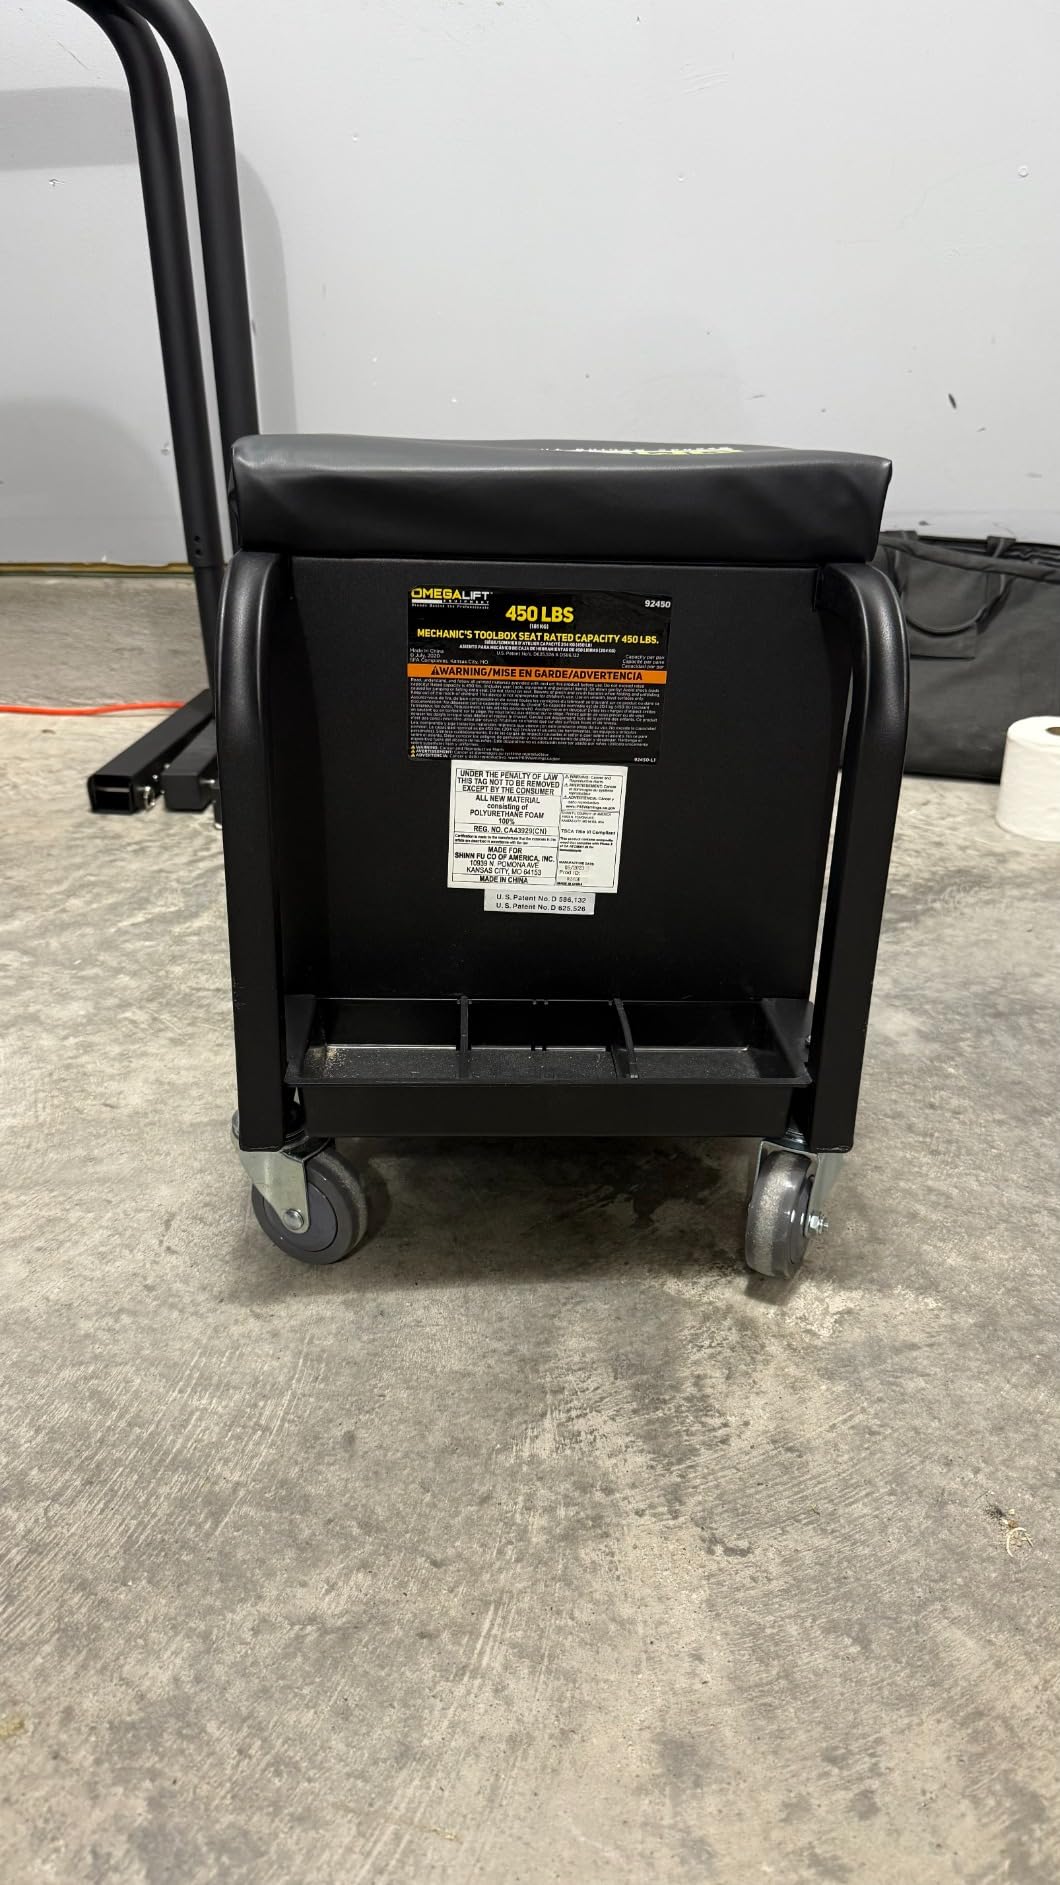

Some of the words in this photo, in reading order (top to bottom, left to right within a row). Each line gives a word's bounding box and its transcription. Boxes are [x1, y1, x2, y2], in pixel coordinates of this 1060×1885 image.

[411, 588, 489, 600] OMEGALIFT
[644, 600, 671, 608] 92450
[505, 605, 538, 621] 450
[541, 606, 574, 623] LBS
[417, 628, 472, 639] MECHANIC'S
[473, 631, 518, 640] TOOLBOX
[519, 632, 542, 641] SEAT
[544, 633, 574, 642] RATED
[575, 634, 621, 643] CAPACITY
[622, 635, 638, 644] 450
[640, 636, 659, 645] LBS.
[440, 667, 516, 677] WARNING/MISE
[519, 669, 533, 678] EN
[535, 669, 642, 680] GARDE/ADVERTENCIA
[516, 787, 554, 795] CONSUMER
[487, 803, 519, 811] consisting
[470, 809, 524, 818] POLYURETHANE
[494, 868, 510, 876] CITY,
